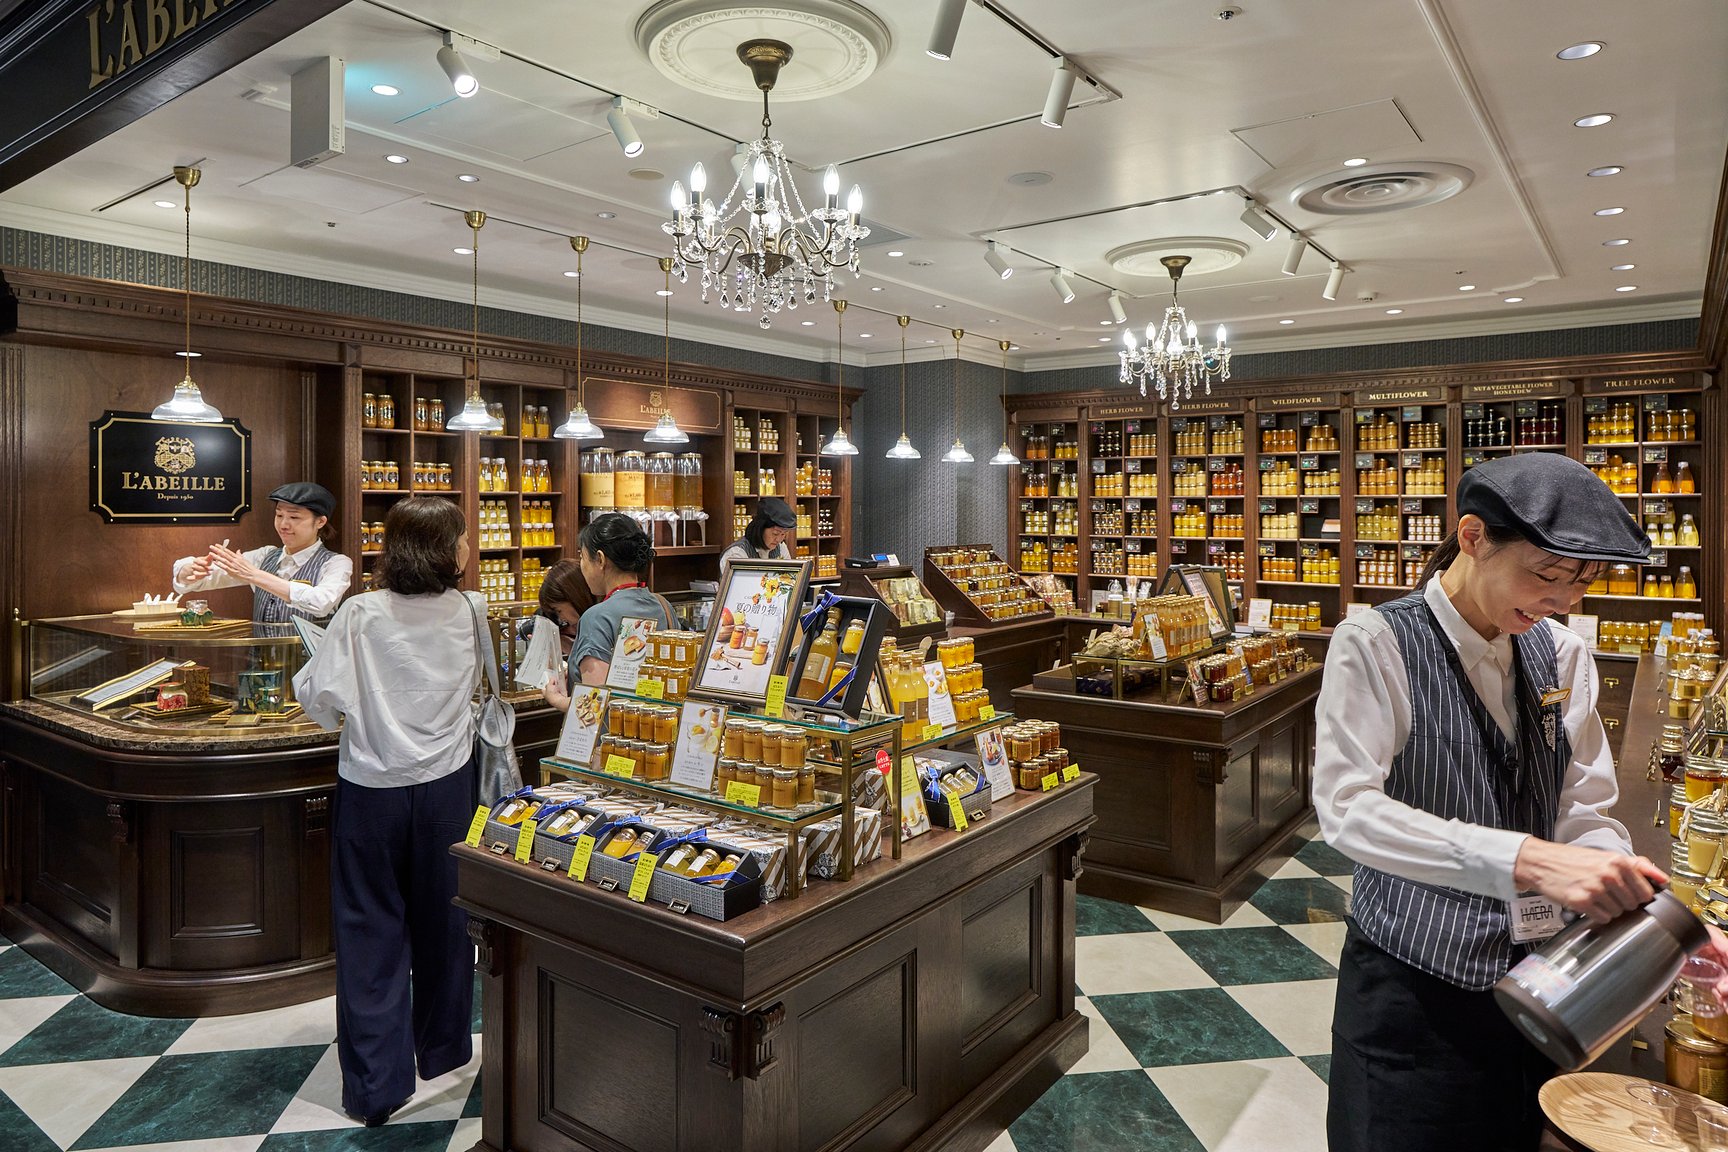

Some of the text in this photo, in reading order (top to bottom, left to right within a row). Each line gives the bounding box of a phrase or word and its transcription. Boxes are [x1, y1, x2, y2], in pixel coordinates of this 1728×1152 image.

[1527, 381, 1554, 389] FLOWER
[1604, 377, 1676, 388] TREE FLOWER
[1369, 391, 1429, 400] MULTIFLOWER
[1493, 388, 1533, 396] HONEYDEW
[1272, 396, 1323, 406] WILDFLOWER
[122, 472, 225, 490] L'ABEILLE
[157, 492, 178, 501] Depuis
[1520, 904, 1554, 922] HAERA
